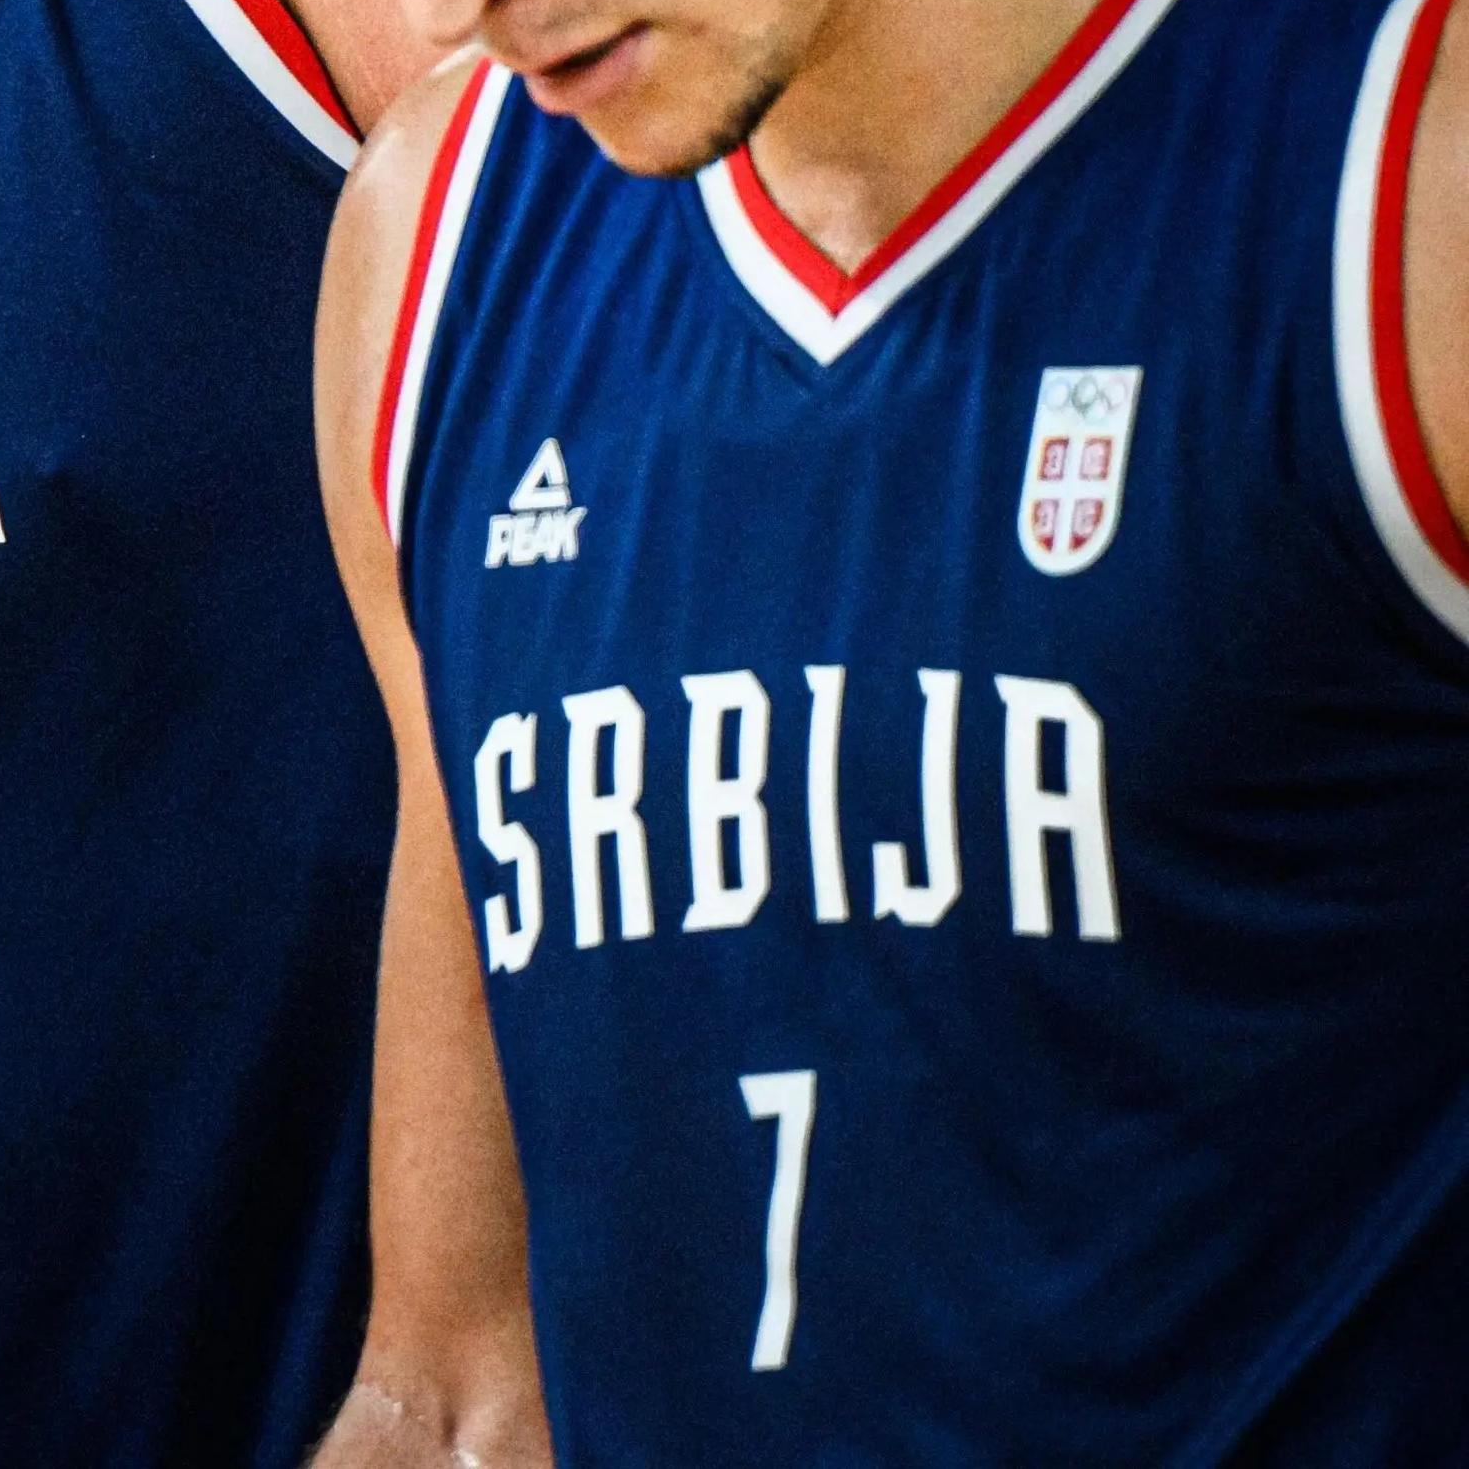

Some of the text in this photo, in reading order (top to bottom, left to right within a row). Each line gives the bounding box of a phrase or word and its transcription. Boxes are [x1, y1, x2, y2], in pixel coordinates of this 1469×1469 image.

[484, 506, 588, 569] PEAK
[473, 664, 1121, 974] SRBIJA
[738, 1069, 817, 1372] 7
